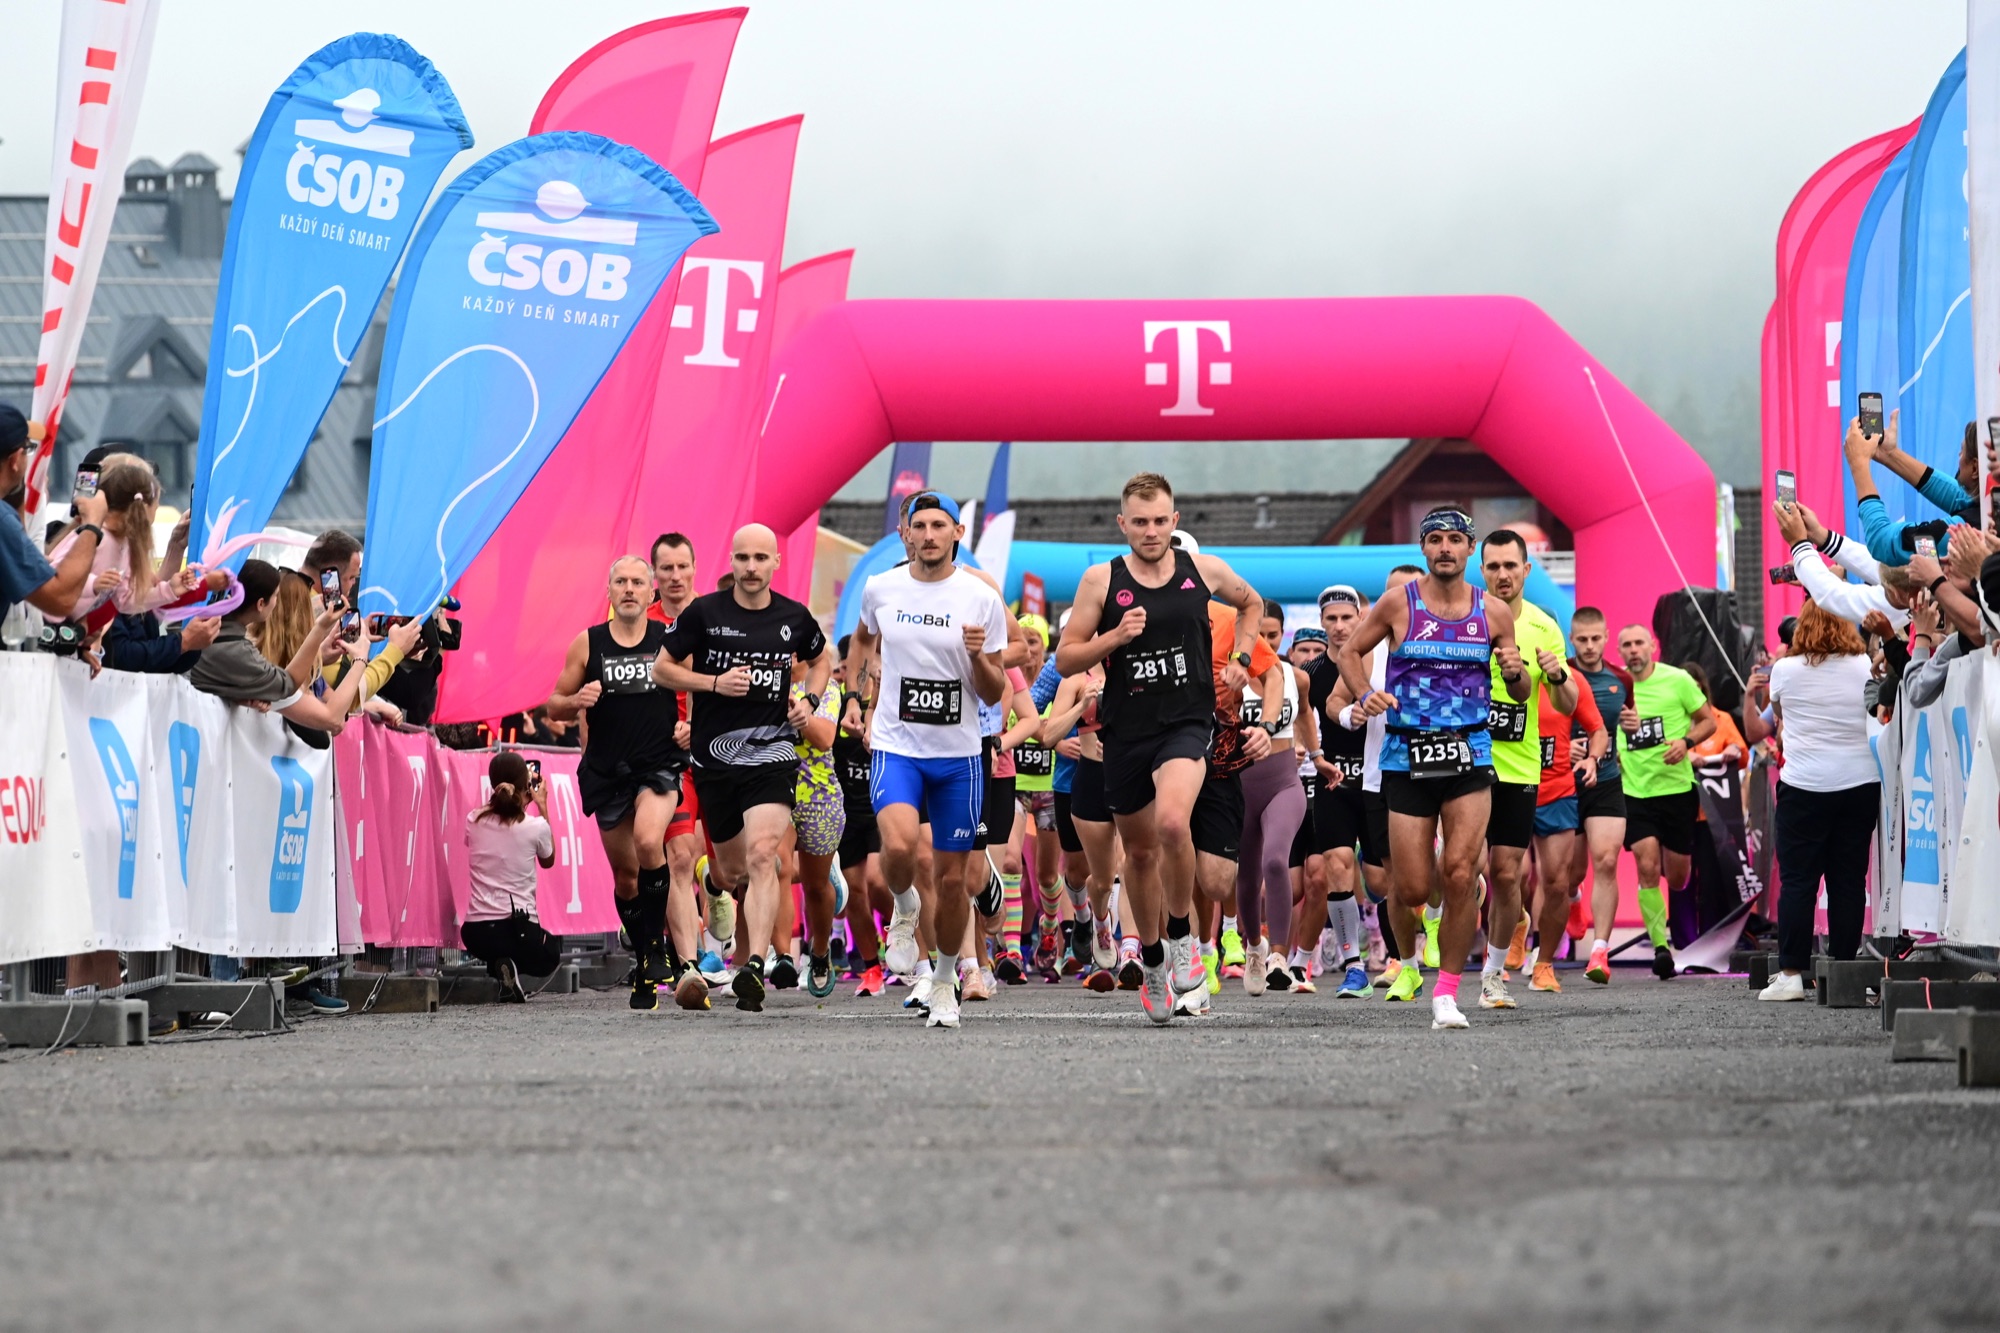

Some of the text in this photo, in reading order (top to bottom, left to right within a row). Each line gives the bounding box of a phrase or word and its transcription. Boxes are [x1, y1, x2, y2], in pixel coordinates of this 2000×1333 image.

[285, 141, 405, 221] ČSOB
[279, 213, 391, 252] KAŽDÝ DEŇ SMART
[467, 231, 632, 302] ČSOB
[462, 295, 620, 329] KAŽDÝ DEŇ SMART
[1143, 320, 1232, 416] T
[1404, 645, 1489, 659] DIGITAL RUNNERS
[605, 663, 646, 682] 1093
[745, 668, 774, 688] 09
[1132, 658, 1168, 679] 281
[907, 689, 944, 709] 208
[1411, 742, 1459, 763] 1235
[1335, 762, 1363, 777] 116
